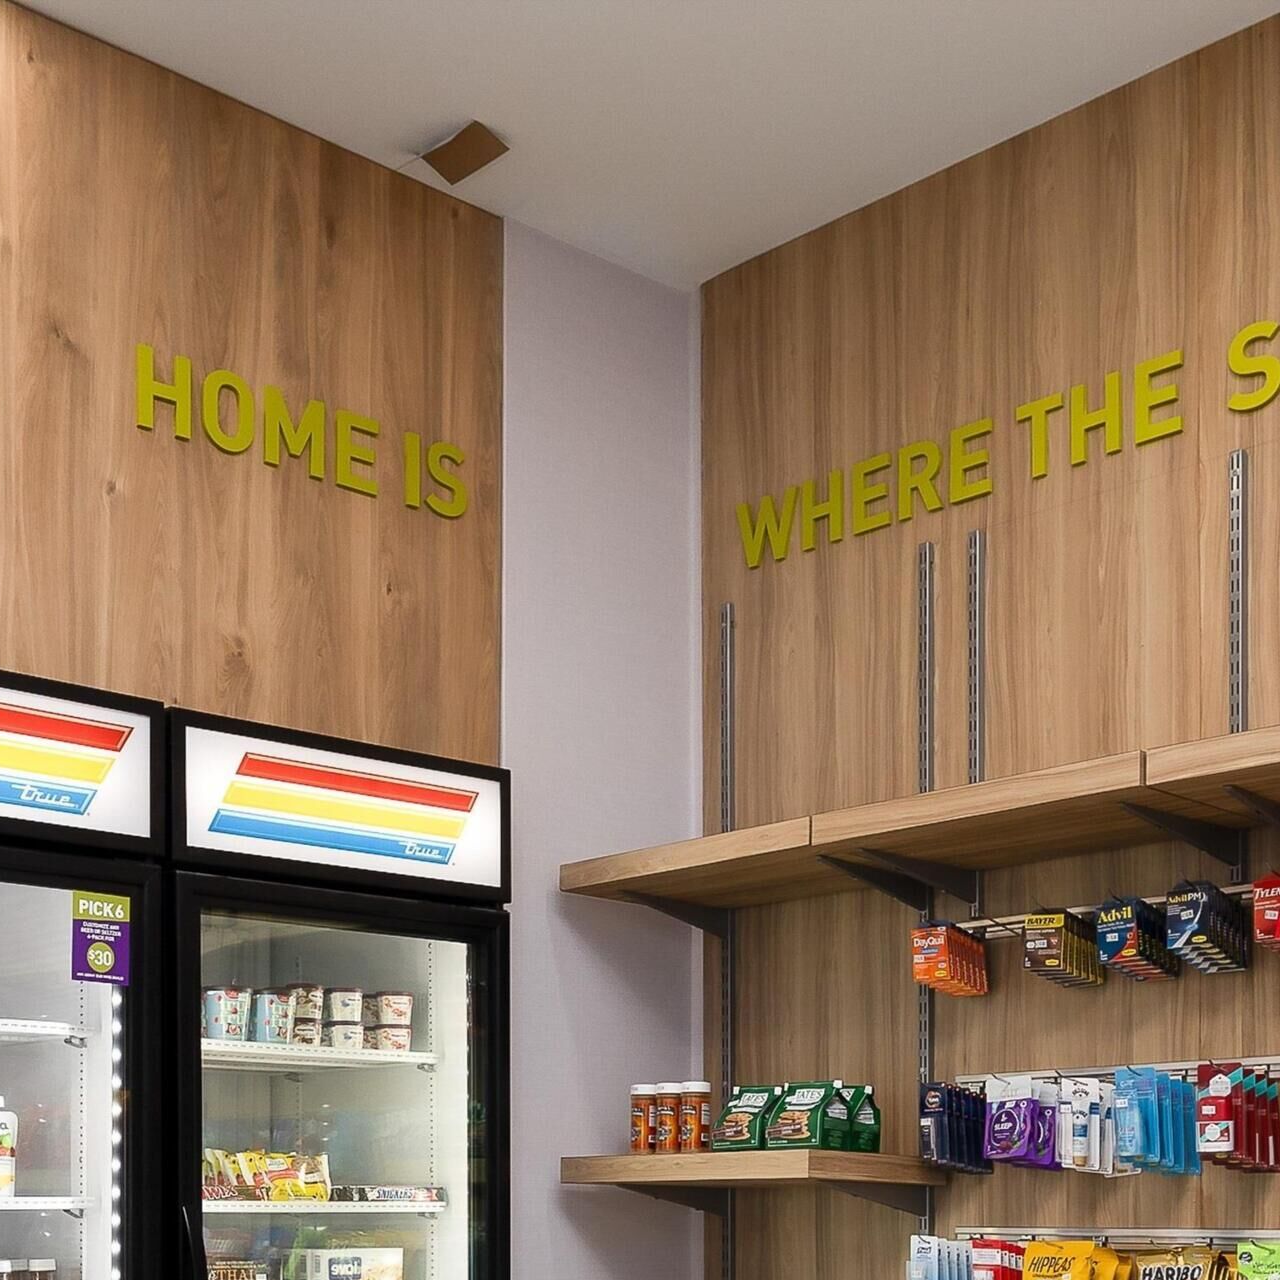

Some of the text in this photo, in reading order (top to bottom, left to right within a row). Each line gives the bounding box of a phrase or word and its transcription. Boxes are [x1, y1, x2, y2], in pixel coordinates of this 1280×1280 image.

[134, 342, 467, 519] HOME IS
[735, 349, 1184, 570] WHERE THE
[10, 782, 78, 809] true
[398, 840, 441, 860] true
[1188, 892, 1202, 901] PM
[79, 899, 125, 919] PICK 6
[1098, 906, 1133, 924] Advil
[1026, 917, 1056, 926] BAYER
[913, 935, 945, 949] DayQuil
[88, 950, 112, 966] $30
[994, 1122, 1013, 1131] SLEEP
[376, 1188, 414, 1199] SNICKERS
[1028, 1256, 1075, 1272] HIPPEAS
